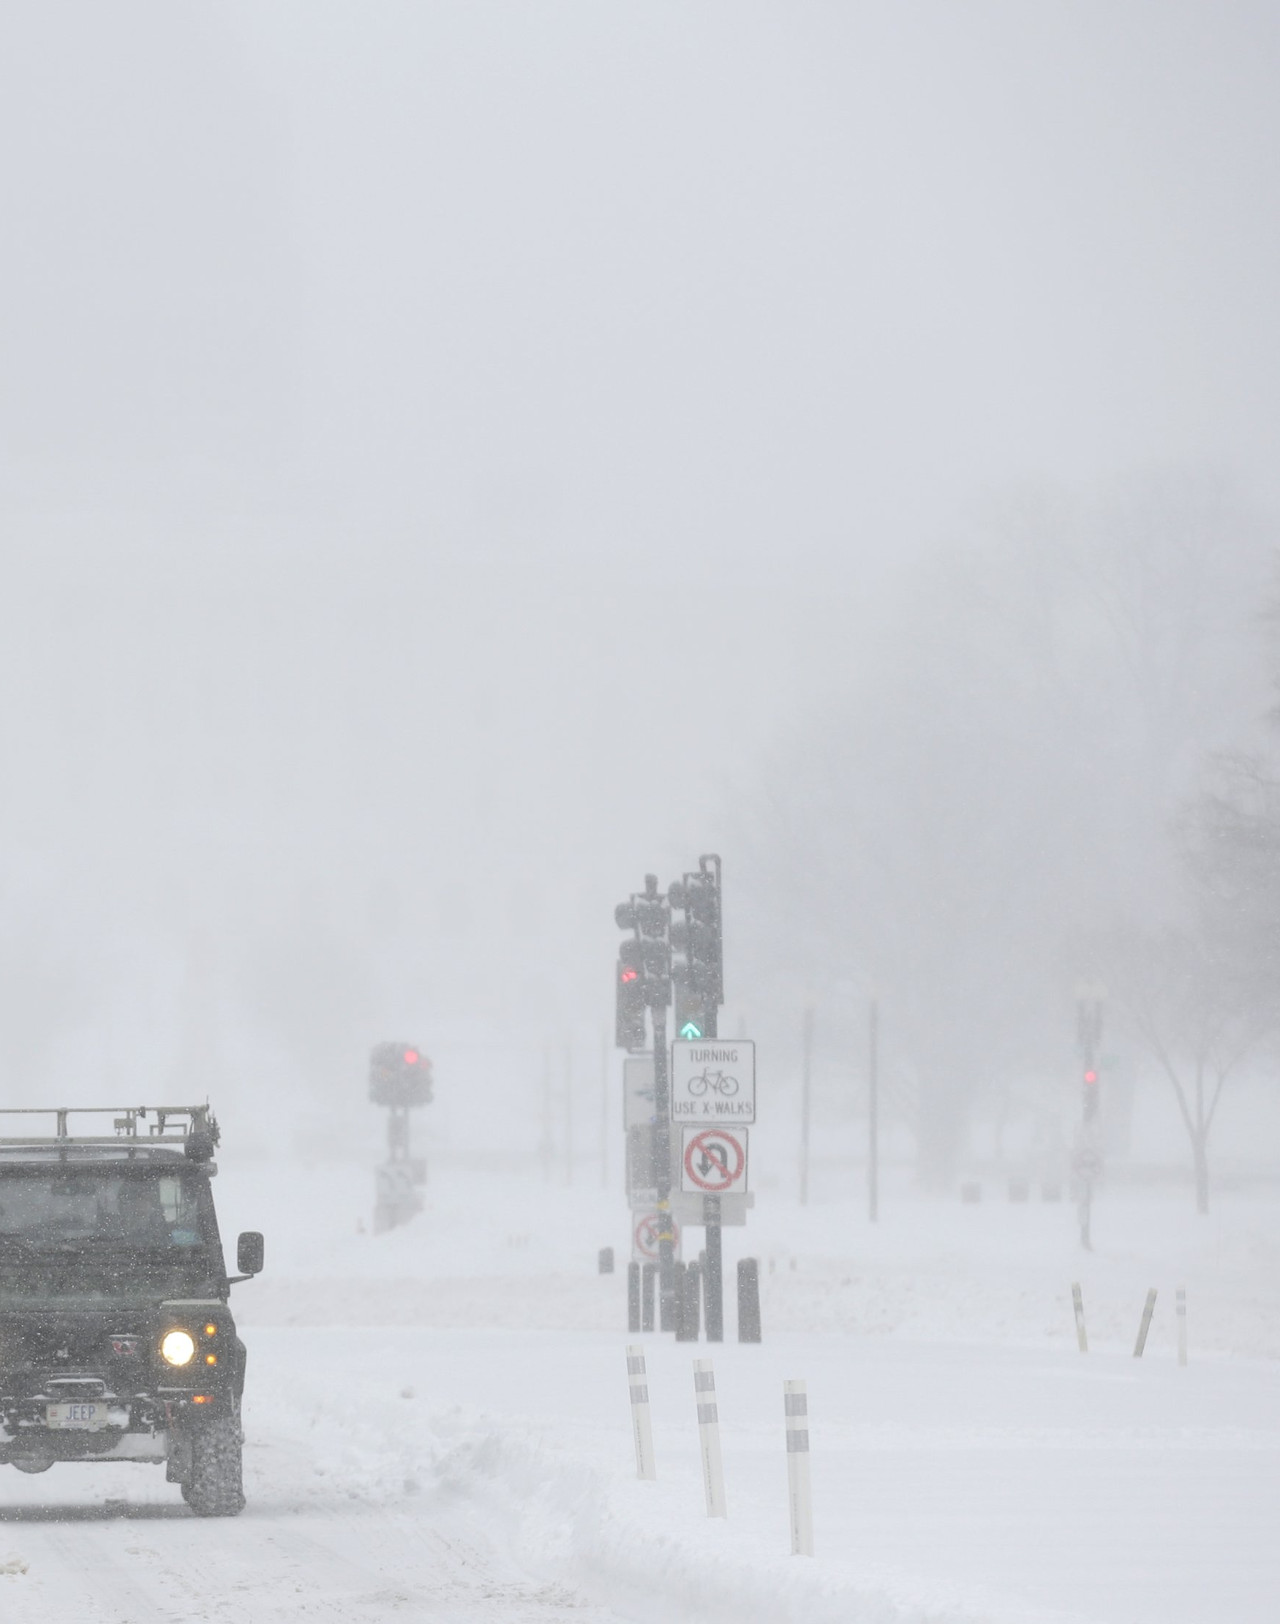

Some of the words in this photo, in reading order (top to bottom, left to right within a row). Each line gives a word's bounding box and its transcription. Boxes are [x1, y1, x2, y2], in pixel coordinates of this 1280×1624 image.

[689, 1049, 738, 1063] TURNING
[674, 1101, 697, 1115] USE
[703, 1101, 753, 1115] X-WALKS
[65, 1405, 96, 1420] JEEP
